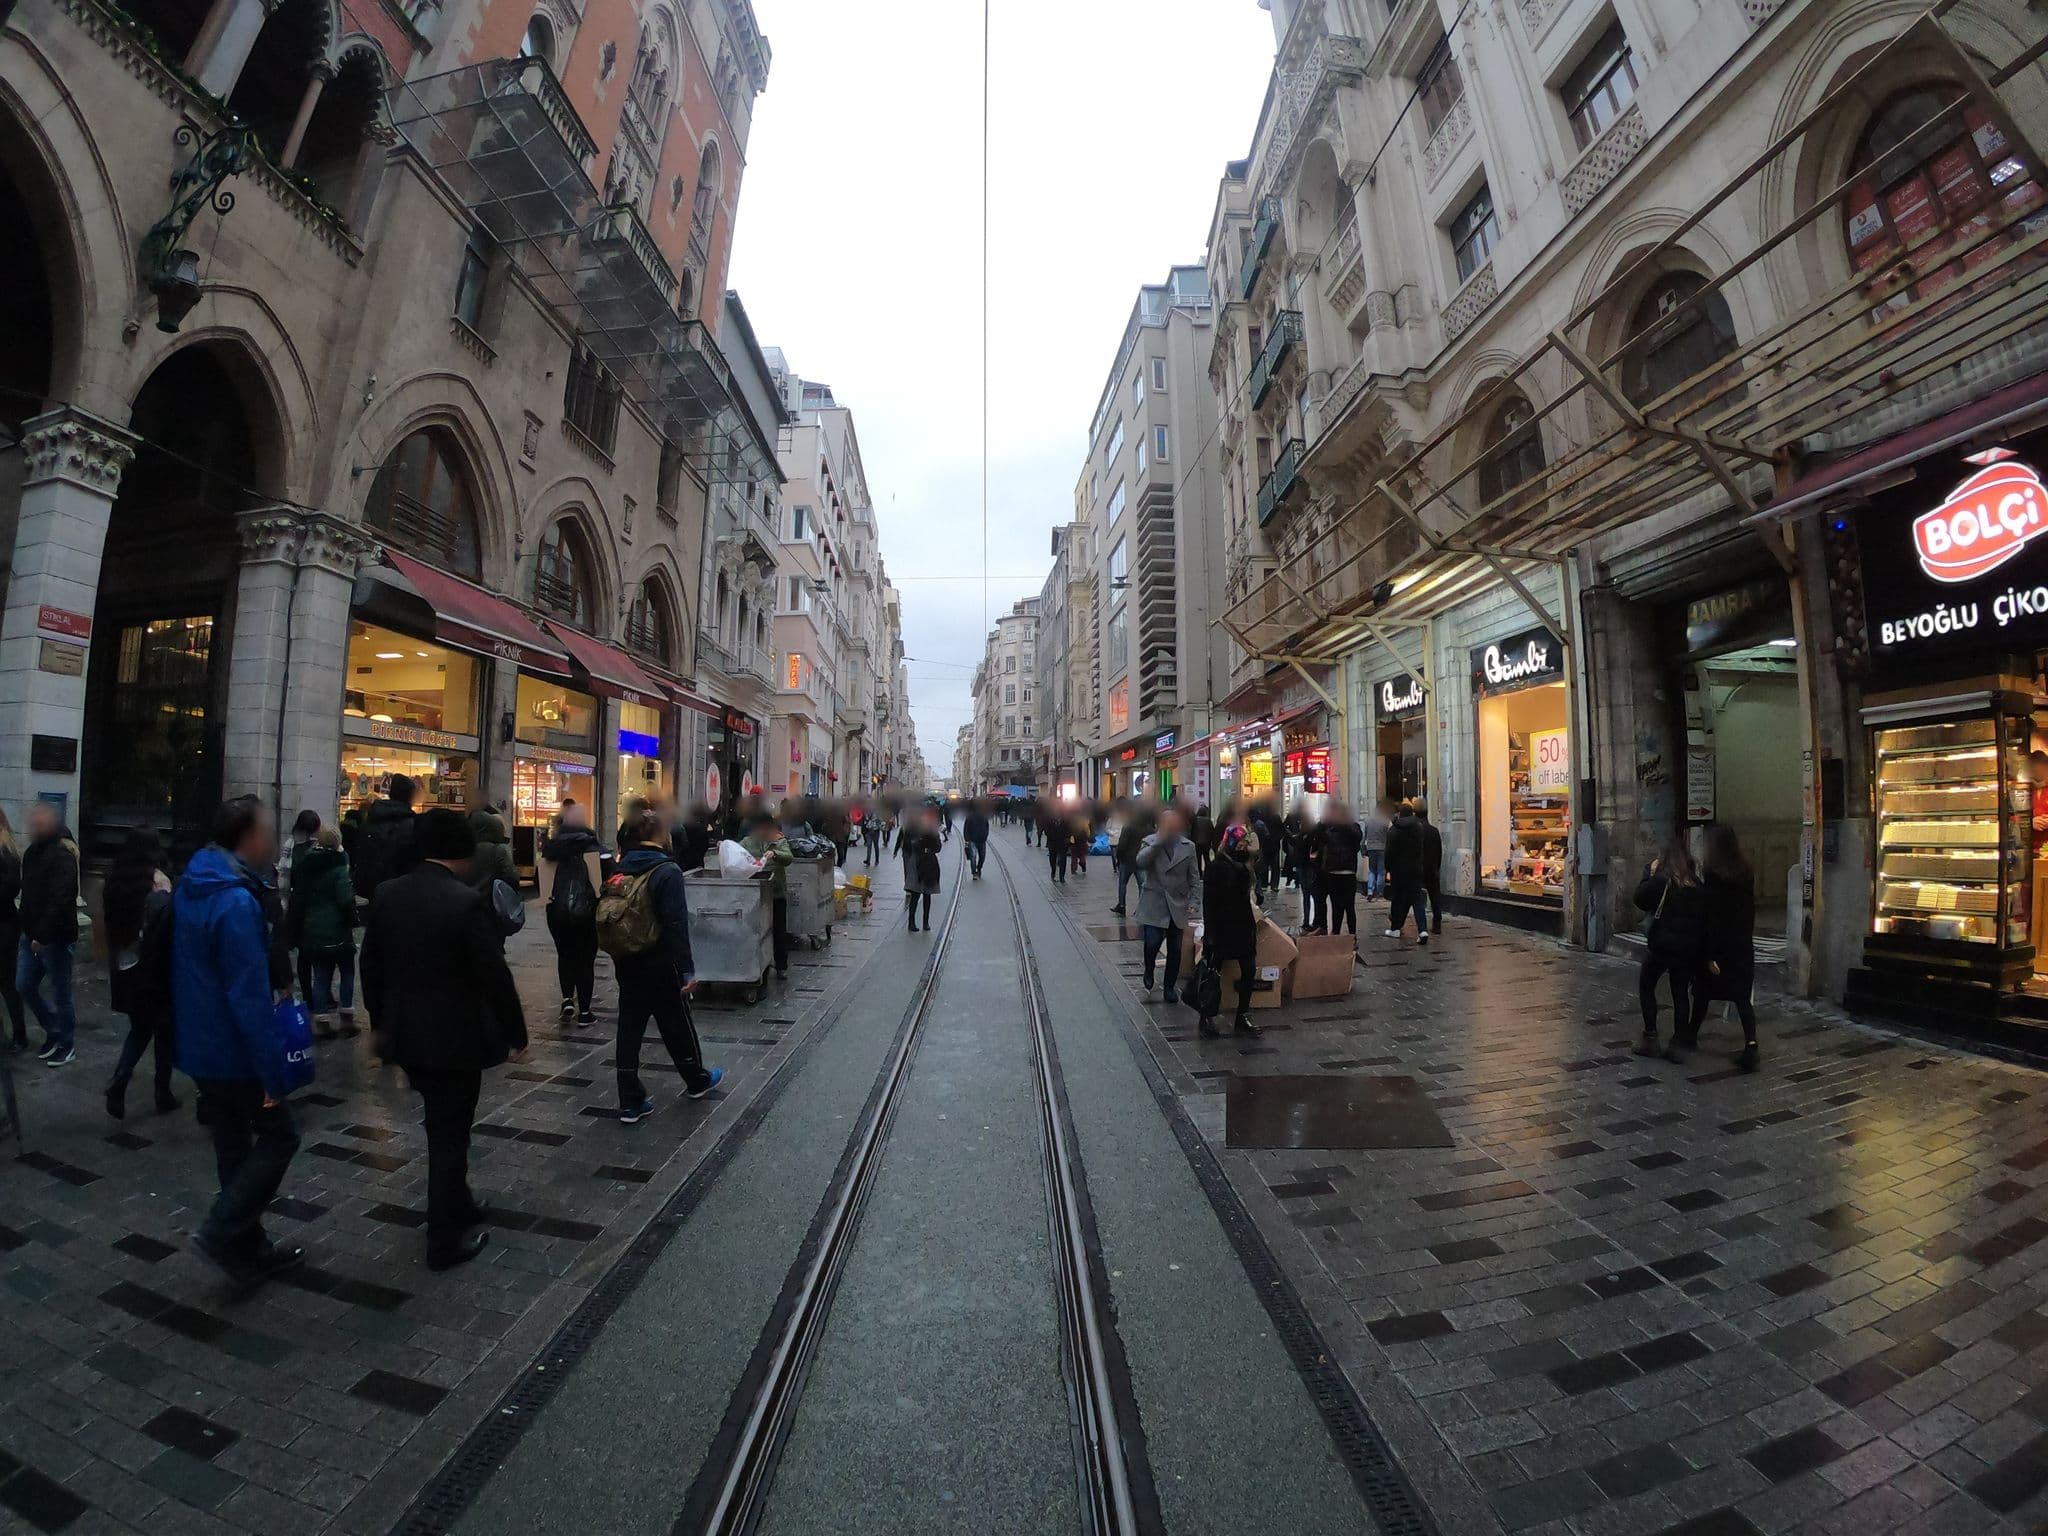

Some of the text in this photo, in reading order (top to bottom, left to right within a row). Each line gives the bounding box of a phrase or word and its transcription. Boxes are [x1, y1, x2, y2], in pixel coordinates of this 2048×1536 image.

[1881, 603, 1979, 645] BEYOĞLU
[494, 639, 522, 662] PİKNİK
[1484, 640, 1548, 684] Bambi
[1383, 680, 1424, 712] Bambi
[371, 722, 416, 743] PİKNİK
[1539, 769, 1550, 785] off
